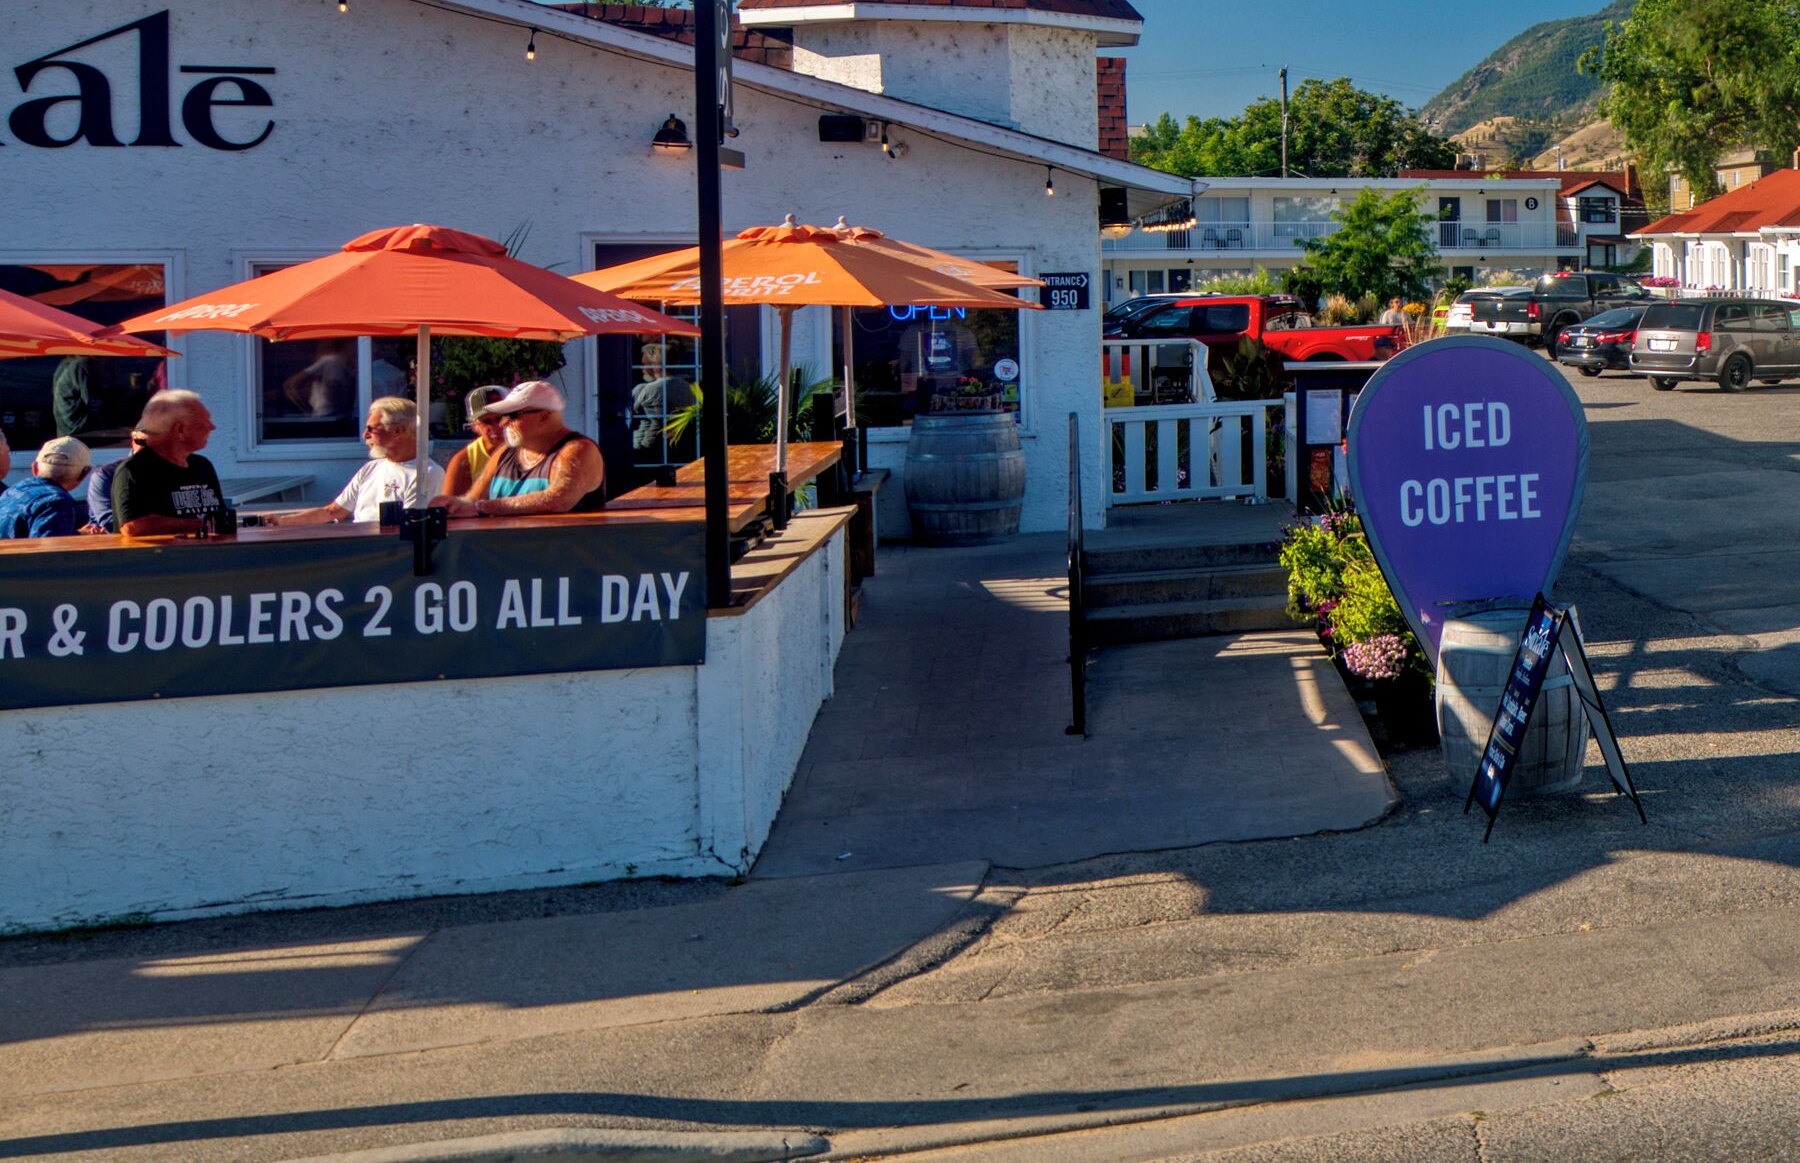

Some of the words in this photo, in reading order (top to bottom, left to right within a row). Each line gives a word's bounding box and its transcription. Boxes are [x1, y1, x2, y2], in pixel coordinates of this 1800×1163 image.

[1051, 289, 1078, 306] 950
[1423, 401, 1511, 451] ICED
[1400, 473, 1542, 528] COFFEE
[48, 603, 87, 657] &
[108, 588, 345, 653] COOLERS
[363, 585, 393, 637] 2
[414, 580, 477, 634] GO
[496, 576, 582, 629] ALL
[601, 572, 690, 623] DAY
